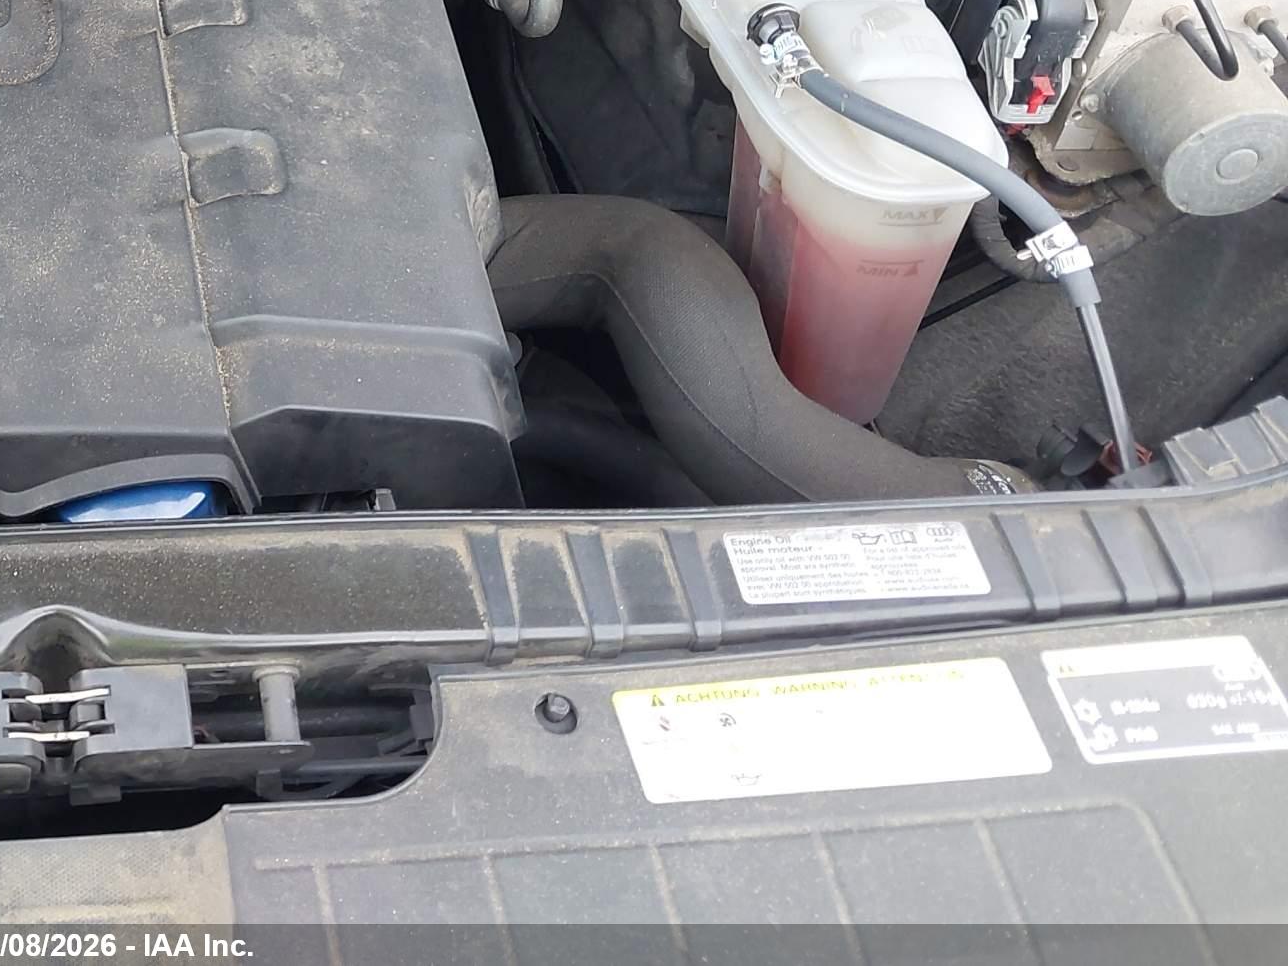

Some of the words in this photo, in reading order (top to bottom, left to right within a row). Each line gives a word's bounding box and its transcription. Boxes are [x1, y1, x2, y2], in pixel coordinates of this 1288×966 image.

[882, 209, 929, 220] MAX
[855, 265, 899, 277] MIN
[730, 537, 772, 547] Engine
[775, 535, 792, 545] Oil
[733, 547, 764, 555] Huile
[767, 545, 813, 554] moteur
[675, 687, 760, 705] ACHTUNG
[772, 679, 857, 698] WARNING
